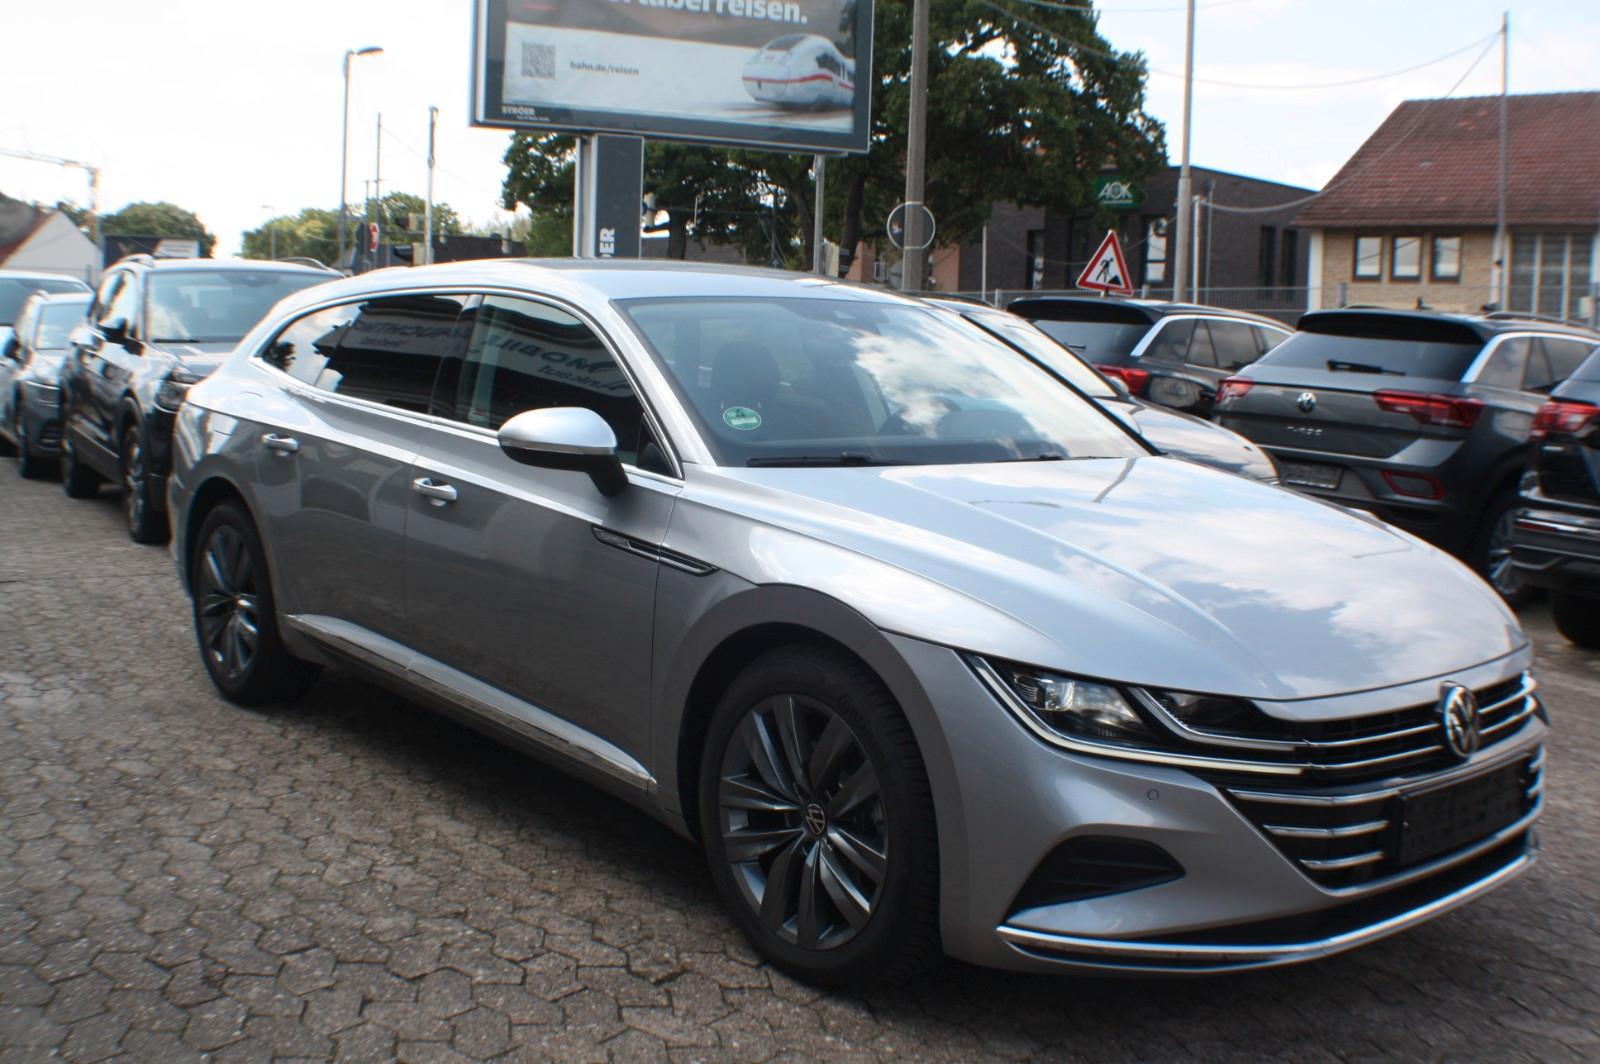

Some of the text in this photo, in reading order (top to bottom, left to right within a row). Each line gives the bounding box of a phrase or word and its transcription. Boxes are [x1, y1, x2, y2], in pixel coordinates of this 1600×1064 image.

[569, 60, 640, 76] bahn.de/reisen
[1098, 181, 1132, 200] AOK
[599, 227, 615, 258] ER
